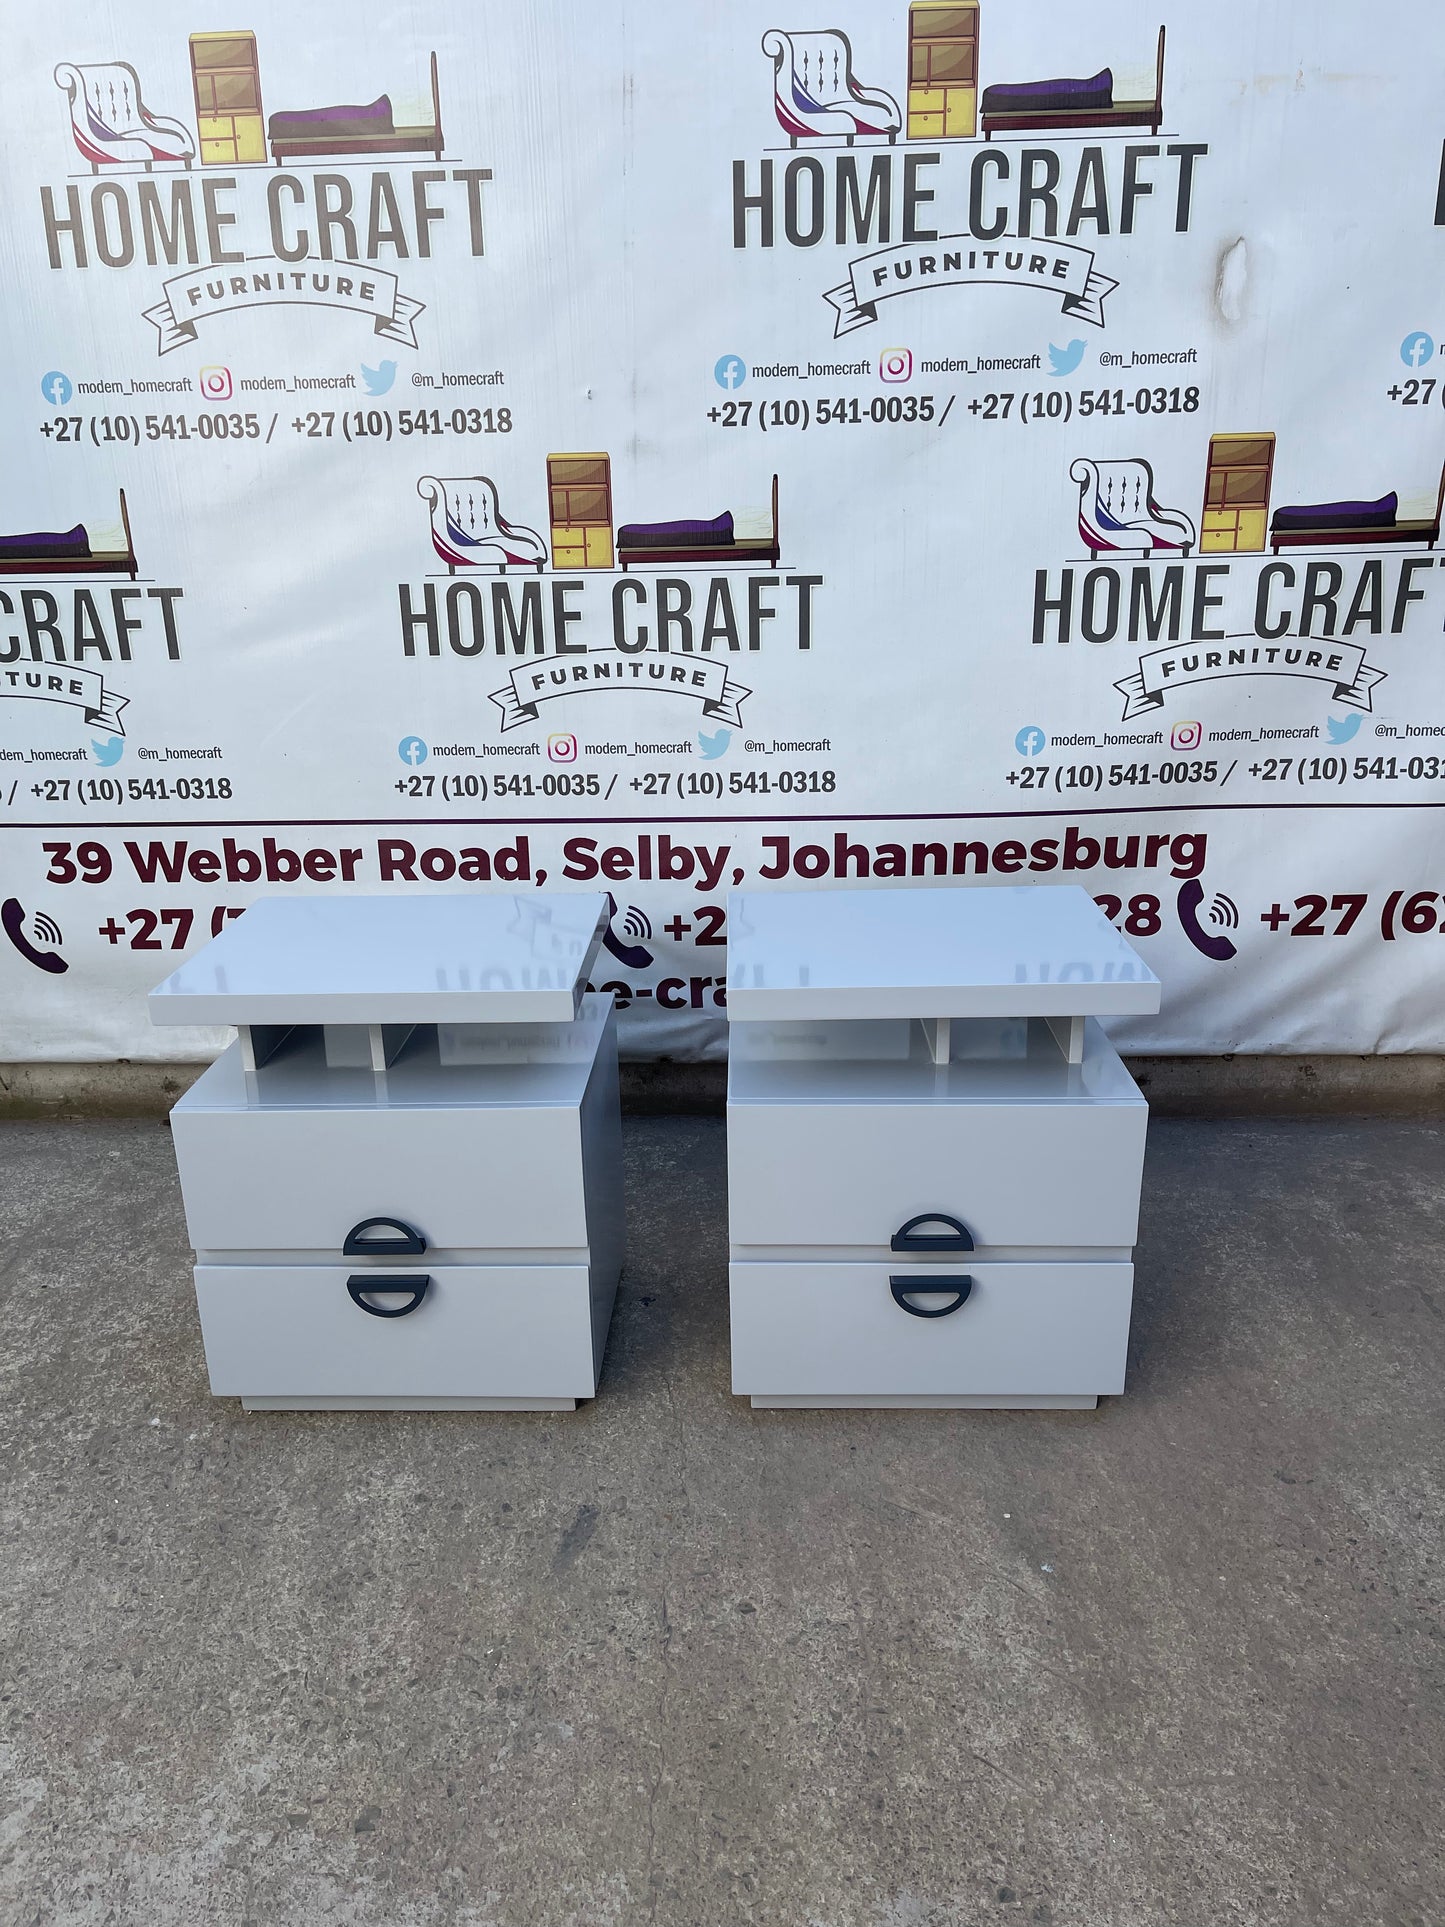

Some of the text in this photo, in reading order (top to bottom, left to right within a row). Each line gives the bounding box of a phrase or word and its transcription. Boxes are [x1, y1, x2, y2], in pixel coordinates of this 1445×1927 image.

[732, 143, 1209, 249] HOME CRAFT
[39, 168, 493, 270] HOME CRAFT
[872, 250, 1070, 287] FURNITURE
[186, 272, 376, 307] FURNITURE
[1099, 348, 1198, 369] @m_homecraft
[411, 370, 505, 390] @m_homecraft
[1386, 378, 1437, 406] +27
[39, 416, 83, 442] +27
[90, 415, 140, 447] (10)
[144, 413, 261, 441] 541-0035
[291, 411, 336, 438] +27
[342, 410, 393, 443] (10)
[398, 407, 513, 436] 541-0318
[706, 401, 753, 427] +27
[759, 399, 810, 432] (10)
[815, 395, 935, 425] 541-0035
[967, 393, 1015, 420] +27
[1020, 391, 1073, 425] (10)
[1078, 386, 1200, 417] 541-0318
[398, 575, 824, 657] HOME CRAFT
[1032, 564, 1231, 645] HOME
[531, 662, 707, 691] FURNITURE
[1161, 647, 1344, 678] FURNITURE
[137, 746, 223, 762] @m_homecraft
[744, 738, 832, 755] @m_homecraft
[30, 779, 71, 801] +27
[77, 778, 124, 806] (10)
[127, 777, 233, 801] 541-0318
[394, 775, 436, 797] +27
[441, 774, 488, 802] (10)
[493, 773, 600, 797] 541-0035
[629, 772, 671, 795] +27
[676, 772, 724, 800] (10)
[728, 770, 836, 794] 541-0318
[1005, 766, 1050, 789] +27
[1054, 765, 1103, 793] (10)
[1108, 760, 1218, 787] 541-0035
[1248, 758, 1294, 781] +27
[1297, 757, 1347, 786] (10)
[41, 826, 1208, 892] 39 Webber Road, Selby, Johannesburg
[98, 908, 194, 950] +27
[1260, 890, 1445, 941] +27 (6
